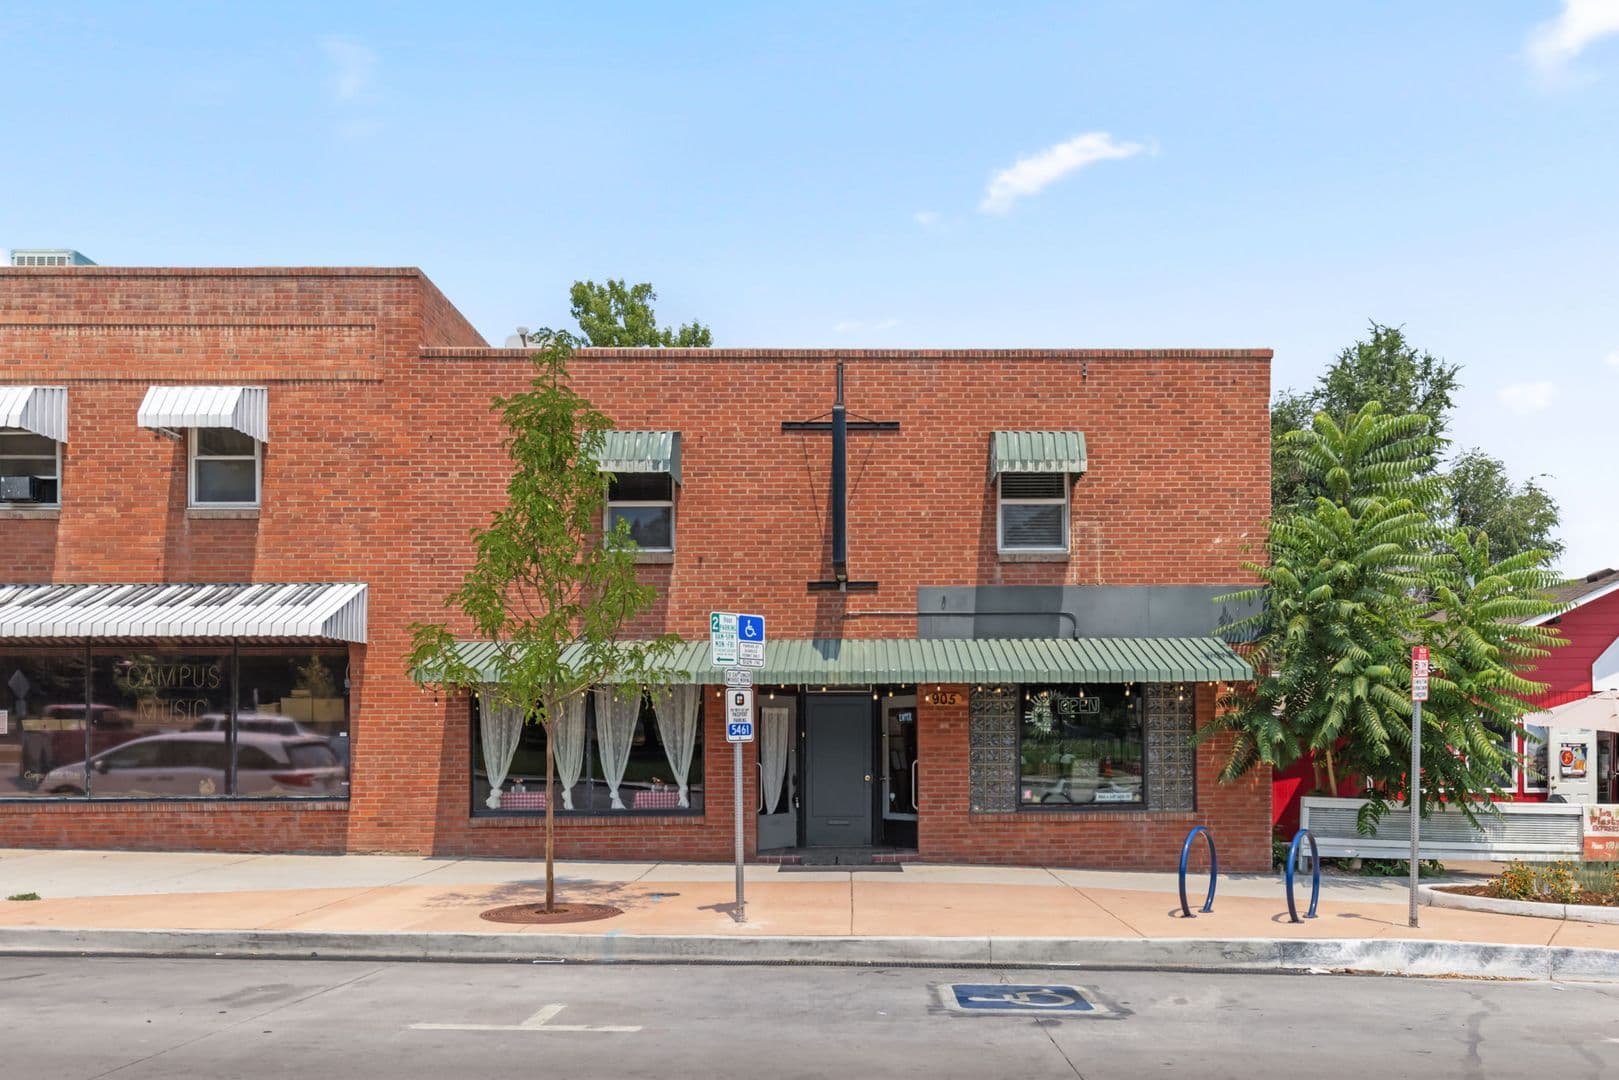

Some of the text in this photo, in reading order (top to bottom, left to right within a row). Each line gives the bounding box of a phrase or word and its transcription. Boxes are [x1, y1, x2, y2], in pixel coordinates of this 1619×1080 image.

[712, 616, 719, 630] 2
[127, 664, 221, 689] CAMPUS
[932, 692, 956, 705] 905
[136, 699, 208, 721] MUSIC
[1059, 699, 1099, 713] OPEN
[731, 724, 750, 735] 5461
